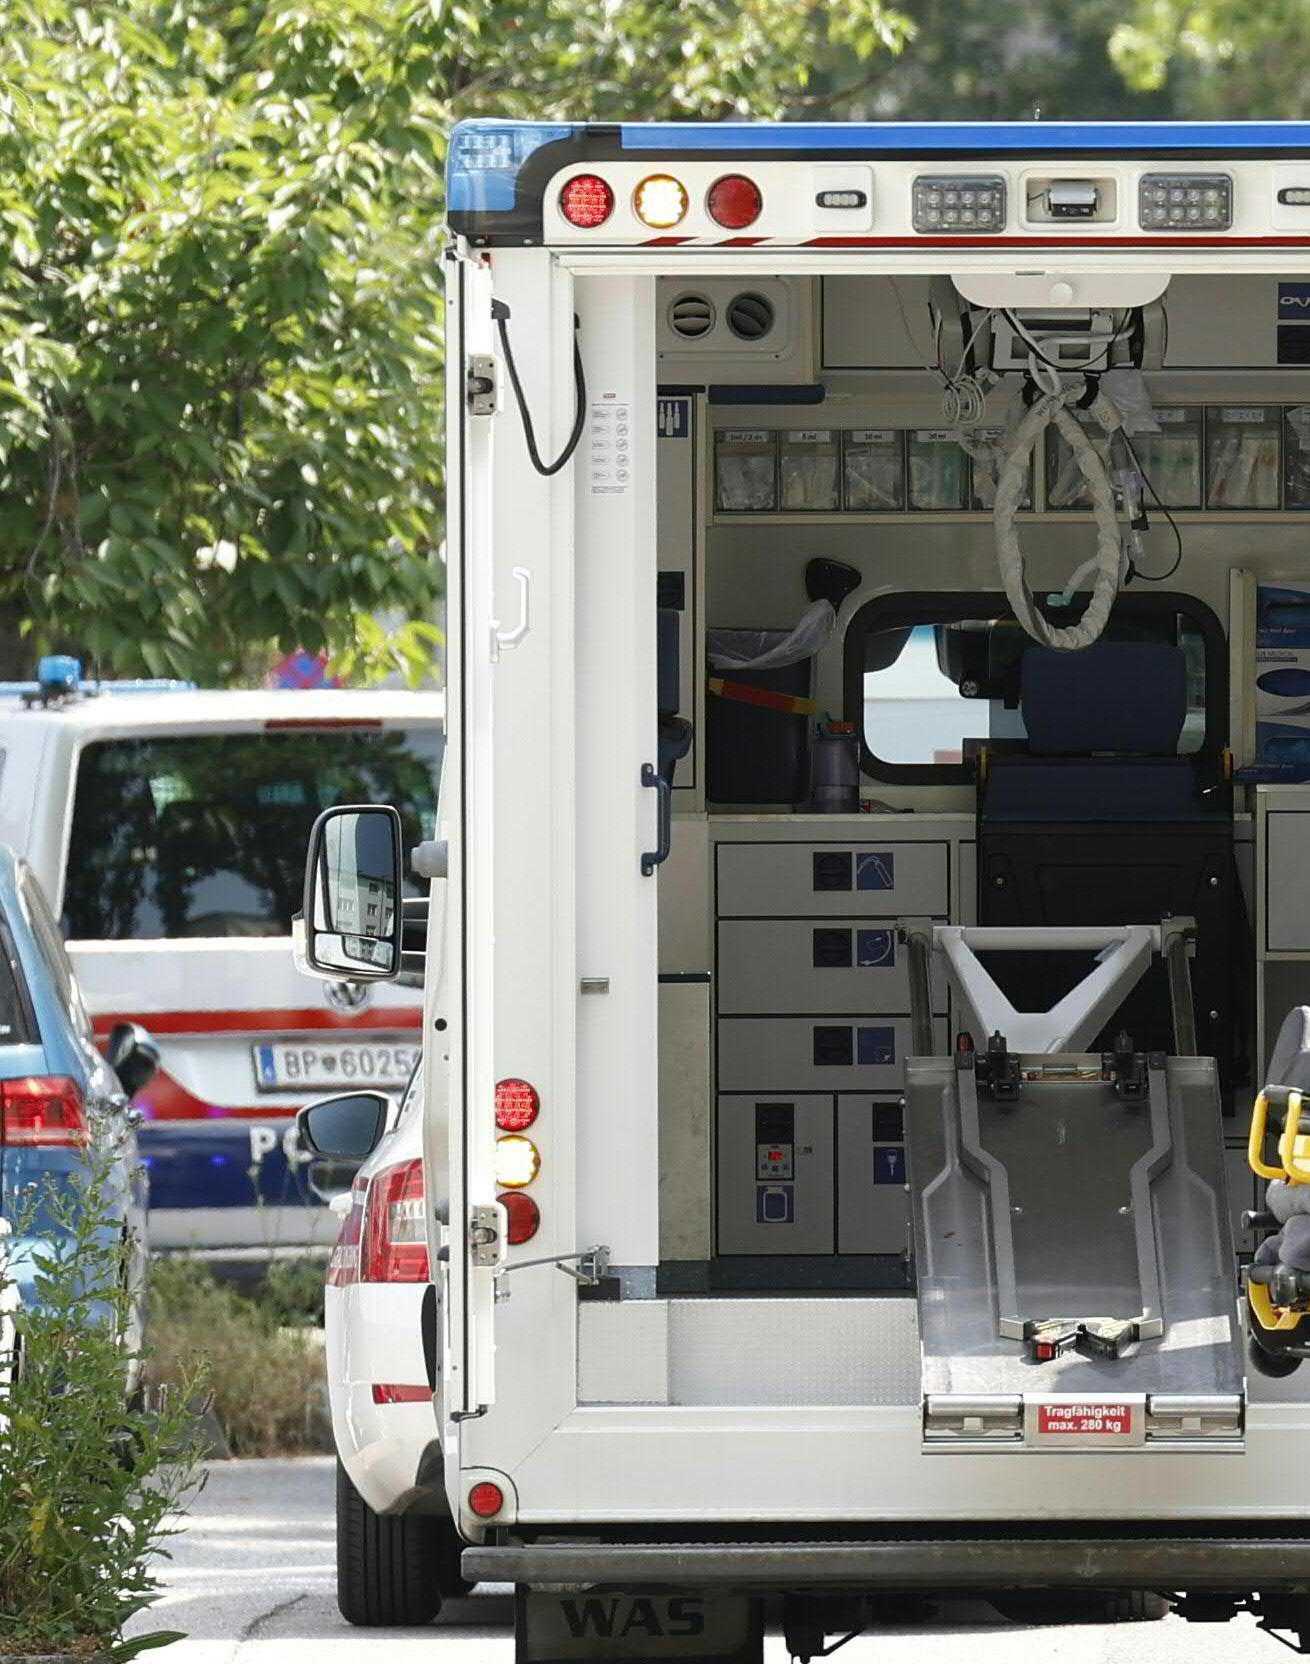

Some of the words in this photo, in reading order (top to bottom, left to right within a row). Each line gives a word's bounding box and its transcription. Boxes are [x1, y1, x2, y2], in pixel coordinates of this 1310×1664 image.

[284, 1049, 317, 1077] BP
[340, 1048, 419, 1077] 6025
[1044, 1405, 1126, 1419] Tragfähigkeit
[1048, 1420, 1078, 1430] max.
[1080, 1419, 1103, 1430] 280
[1105, 1419, 1121, 1433] kg
[560, 1597, 705, 1638] WAS
